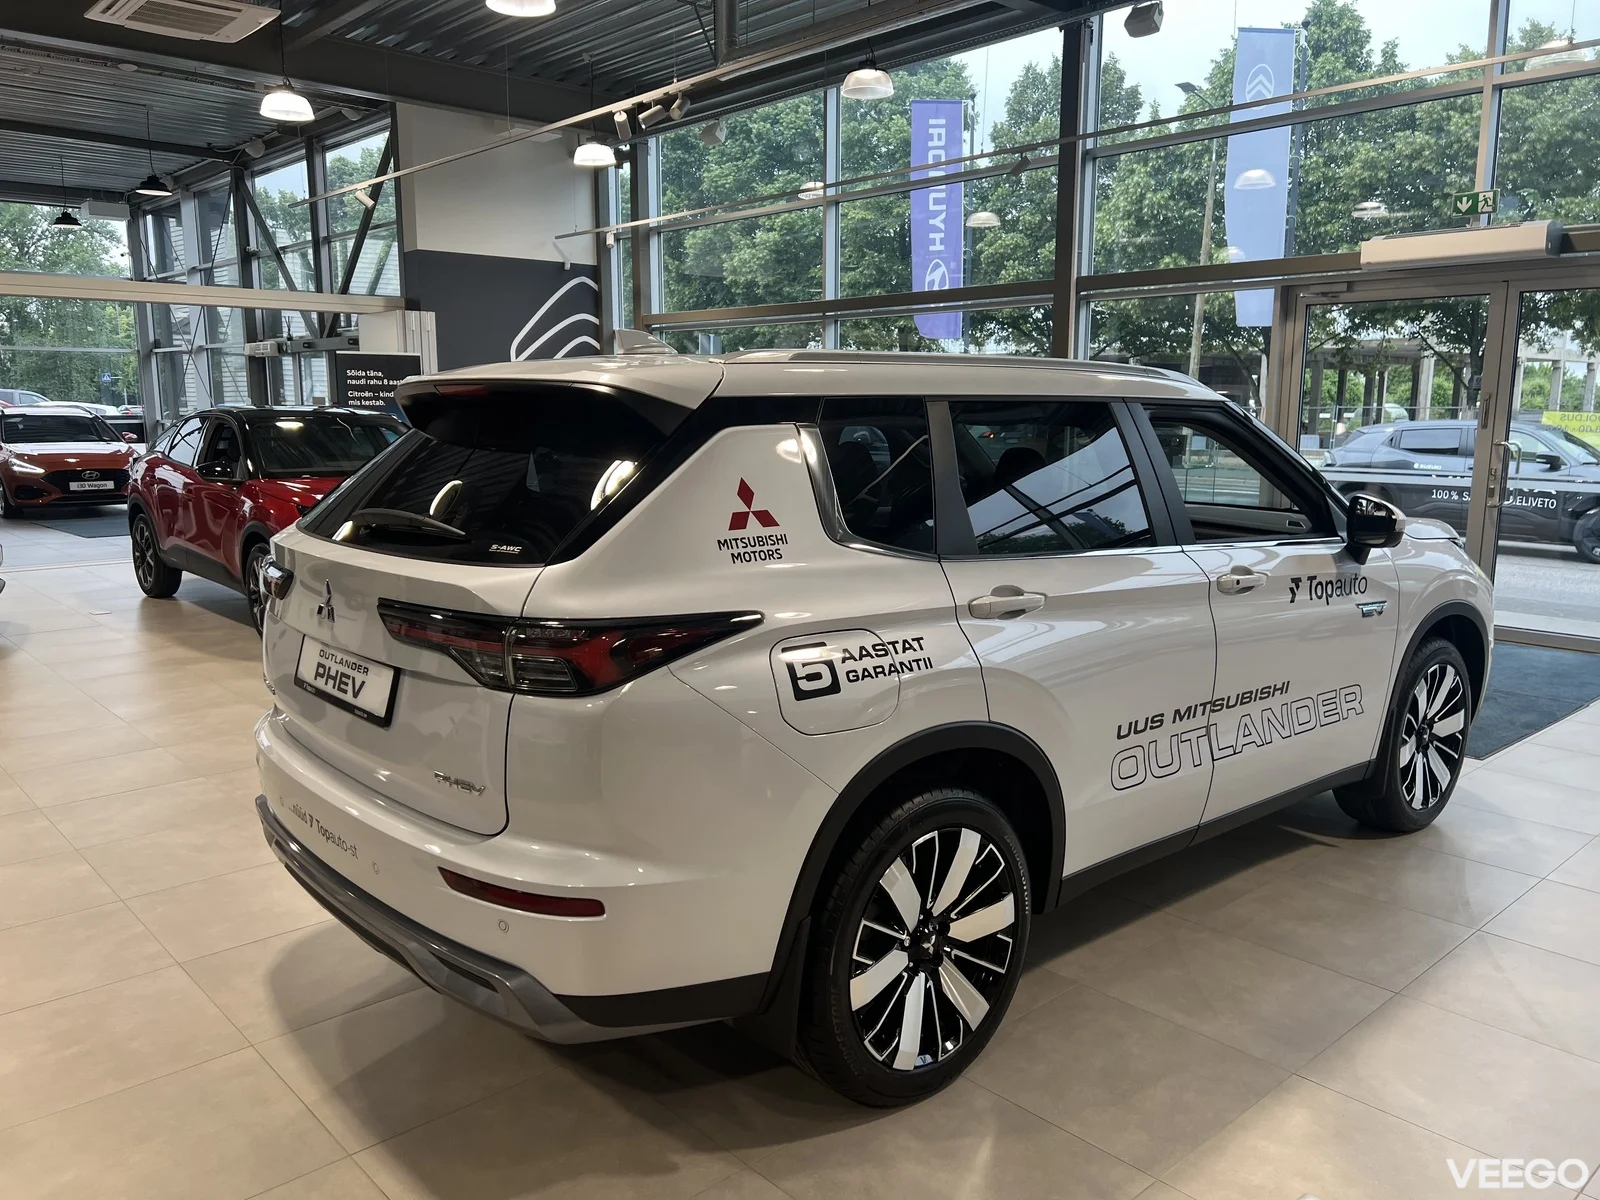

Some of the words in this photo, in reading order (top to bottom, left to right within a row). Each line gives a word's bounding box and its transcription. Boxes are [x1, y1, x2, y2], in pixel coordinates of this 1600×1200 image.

[346, 369, 366, 377] Sõida
[366, 369, 384, 378] täna,
[347, 390, 374, 398] Citroën
[490, 544, 522, 552] S-AWC
[716, 533, 788, 551] MITSUBISHI
[730, 548, 783, 564] MOTORS
[1306, 573, 1368, 606] Topauto
[319, 648, 370, 677] OUTLANDER
[841, 636, 925, 664] AASTAT
[313, 661, 367, 700] PHEV
[788, 645, 838, 695] 5
[845, 656, 934, 683] GARANTII
[1116, 712, 1165, 740] UUS
[1172, 680, 1291, 724] MITSUBISHI
[1110, 683, 1365, 791] OUTLANDER
